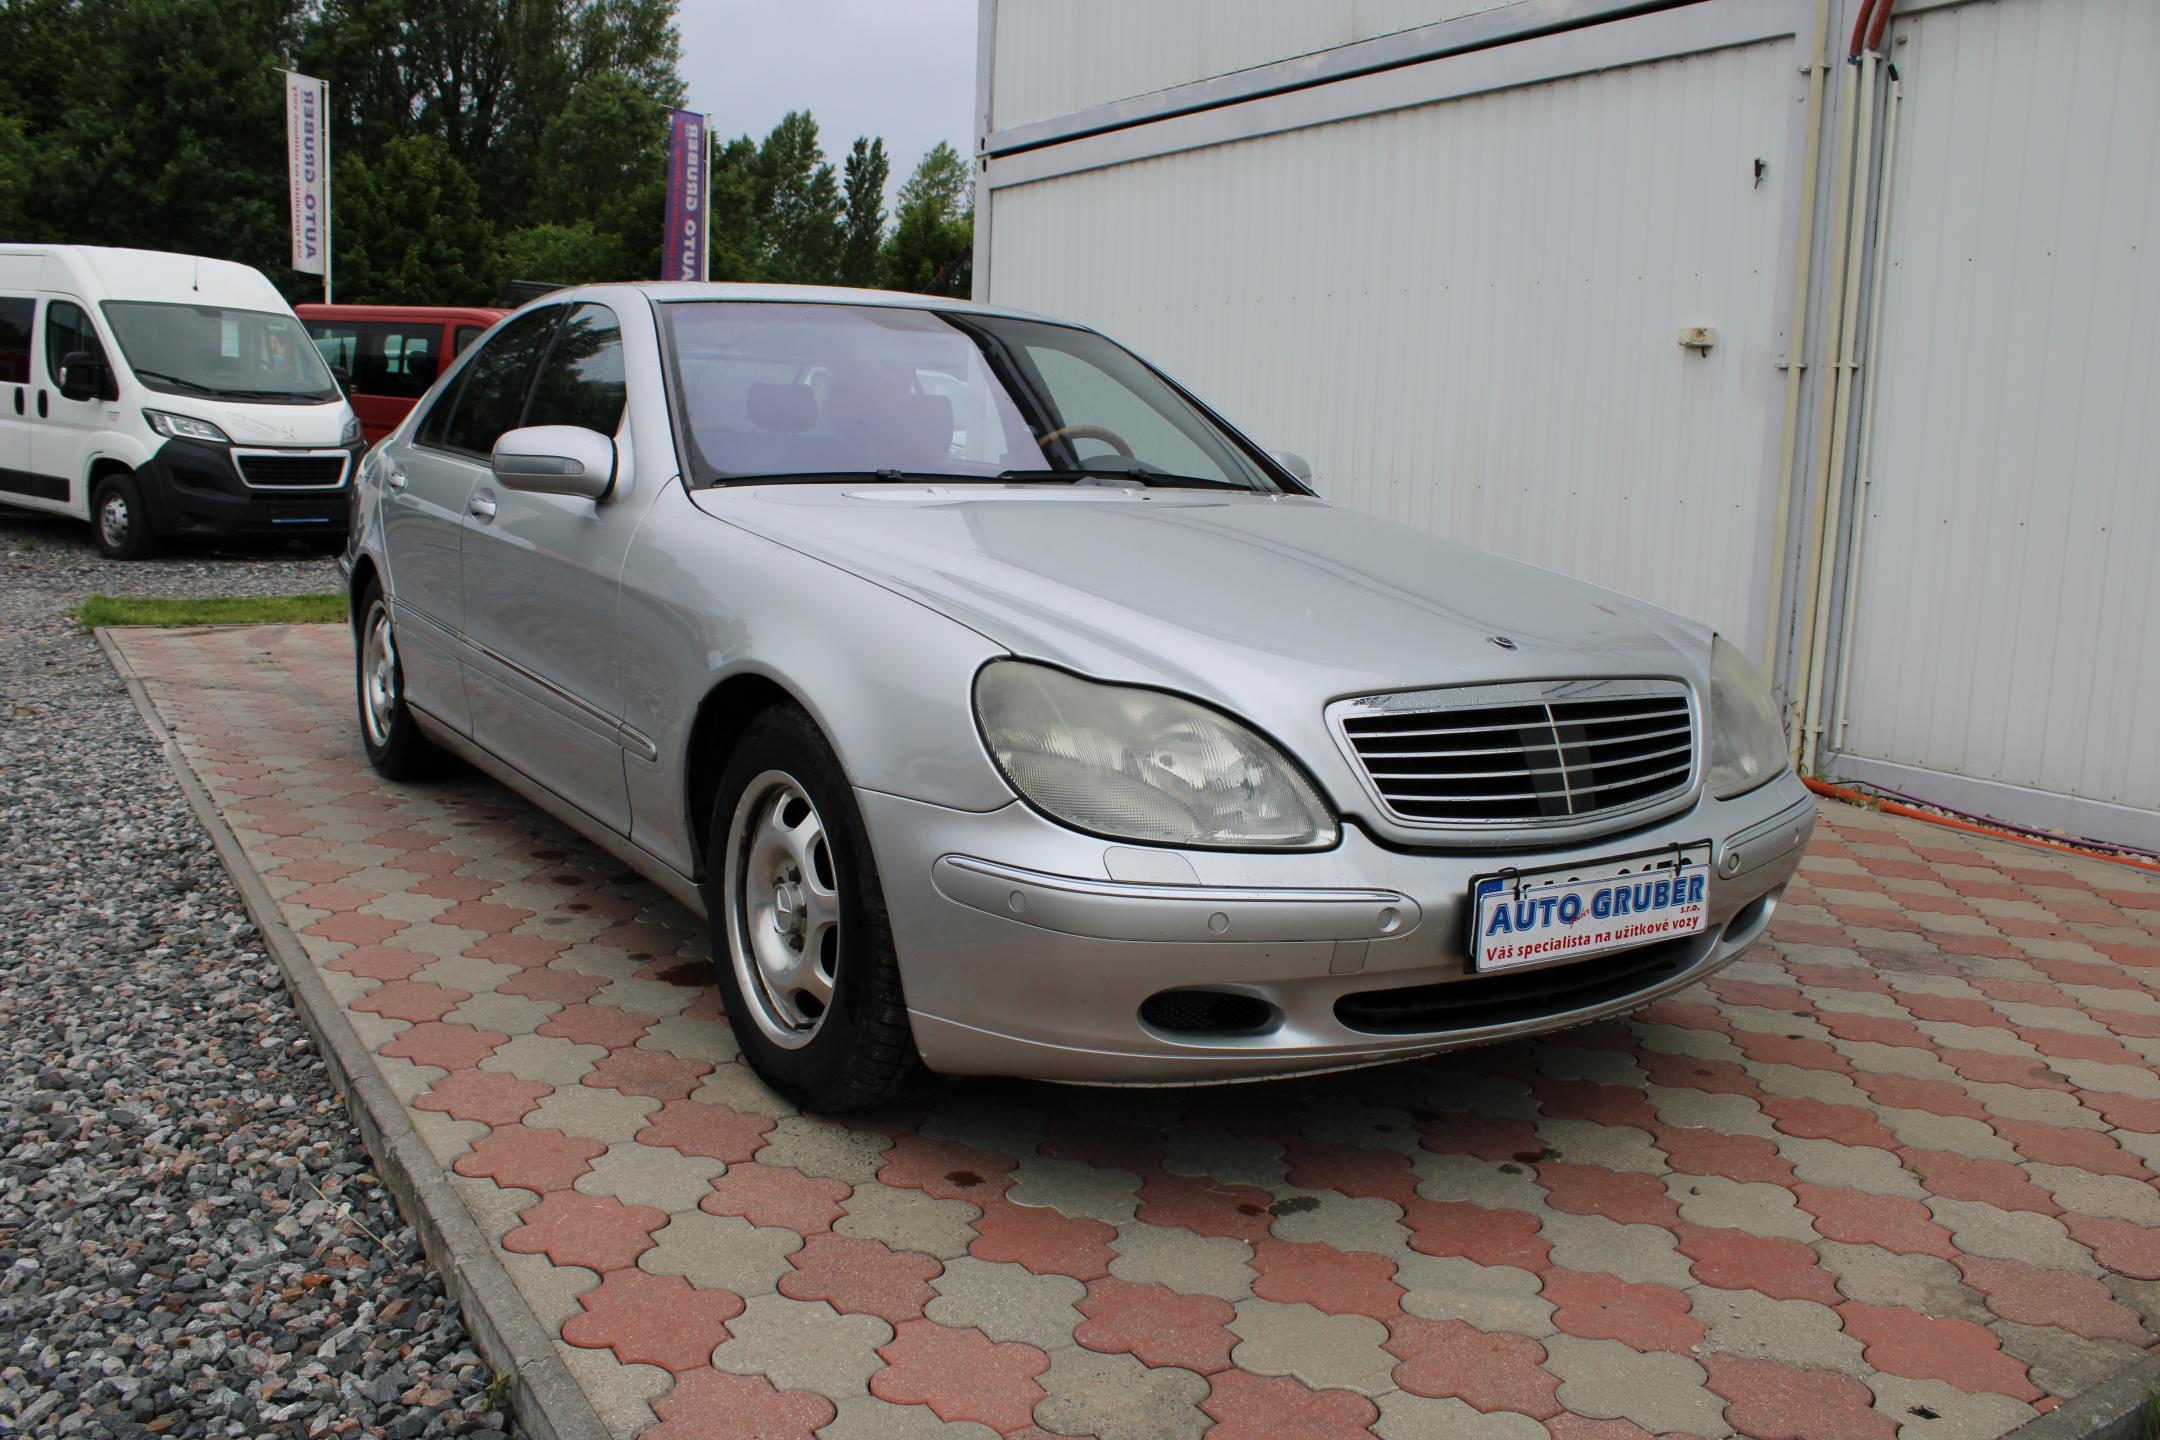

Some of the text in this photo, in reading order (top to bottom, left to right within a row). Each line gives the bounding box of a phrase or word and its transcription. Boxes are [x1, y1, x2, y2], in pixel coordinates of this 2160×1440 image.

[1486, 893, 1582, 937] AUTO
[1590, 873, 1705, 920] GRUBER
[1680, 904, 1700, 914] s.r.o.
[1486, 915, 1699, 962] Váš specialista na užitkové vozy
